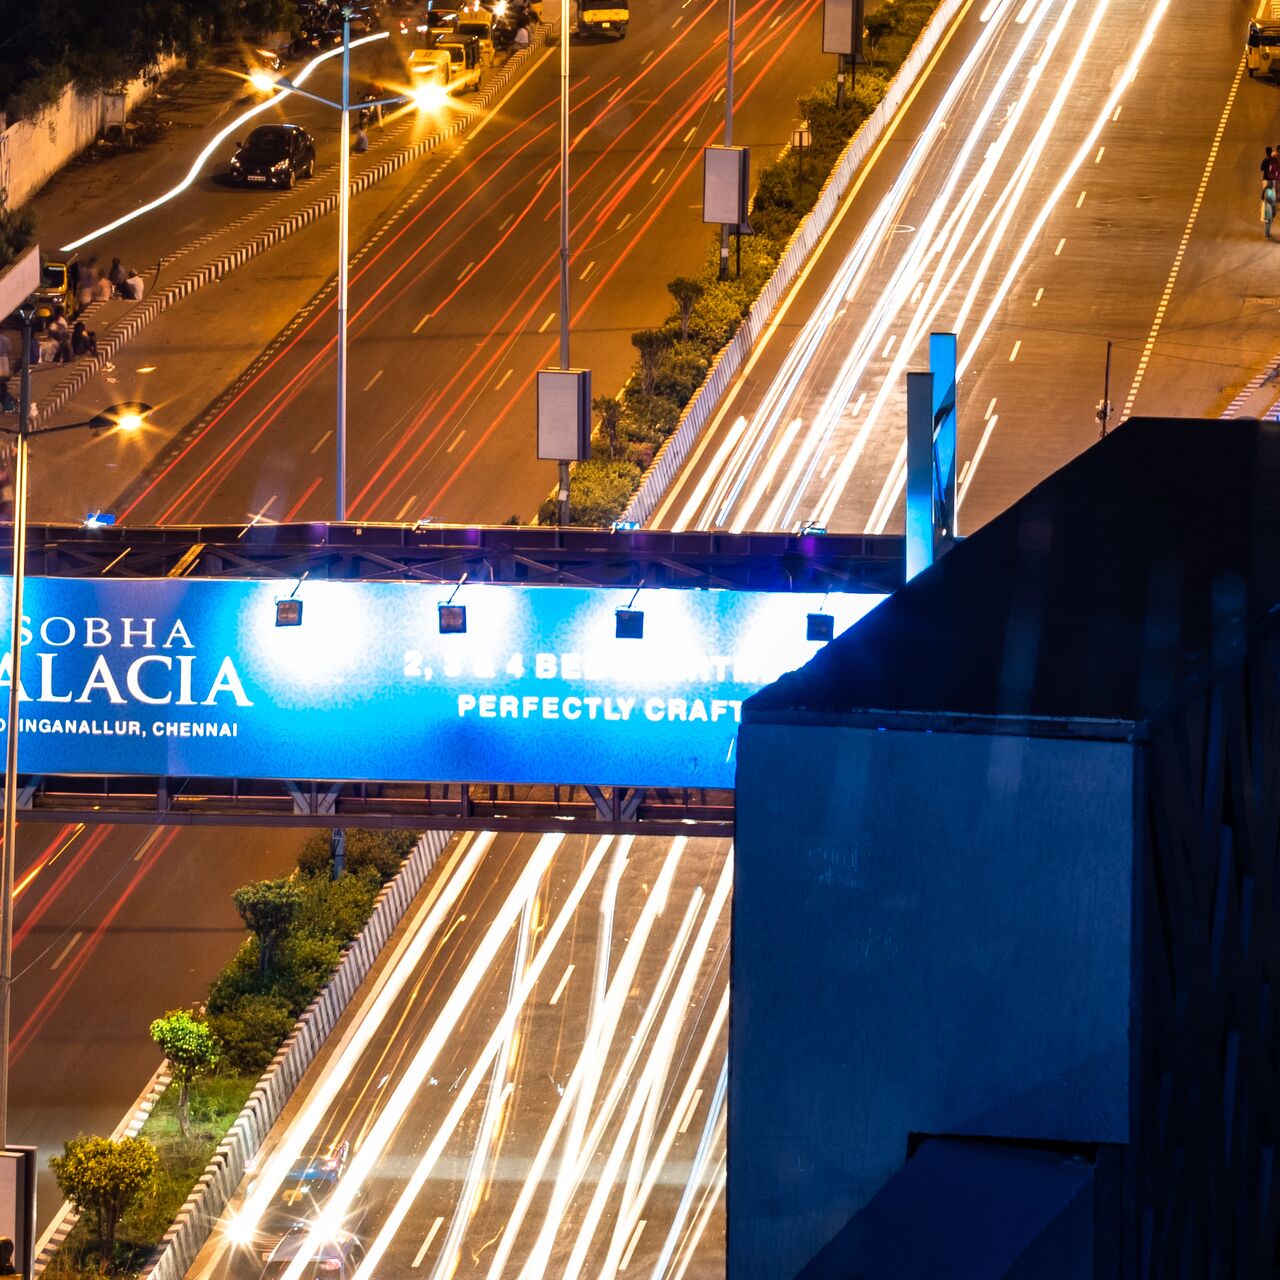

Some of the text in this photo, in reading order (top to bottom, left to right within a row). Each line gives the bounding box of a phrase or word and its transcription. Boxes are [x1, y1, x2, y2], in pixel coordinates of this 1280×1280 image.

[20, 615, 196, 649] SOBHA
[457, 694, 637, 721] PERFECTLY
[152, 721, 238, 737] CHENNAI
